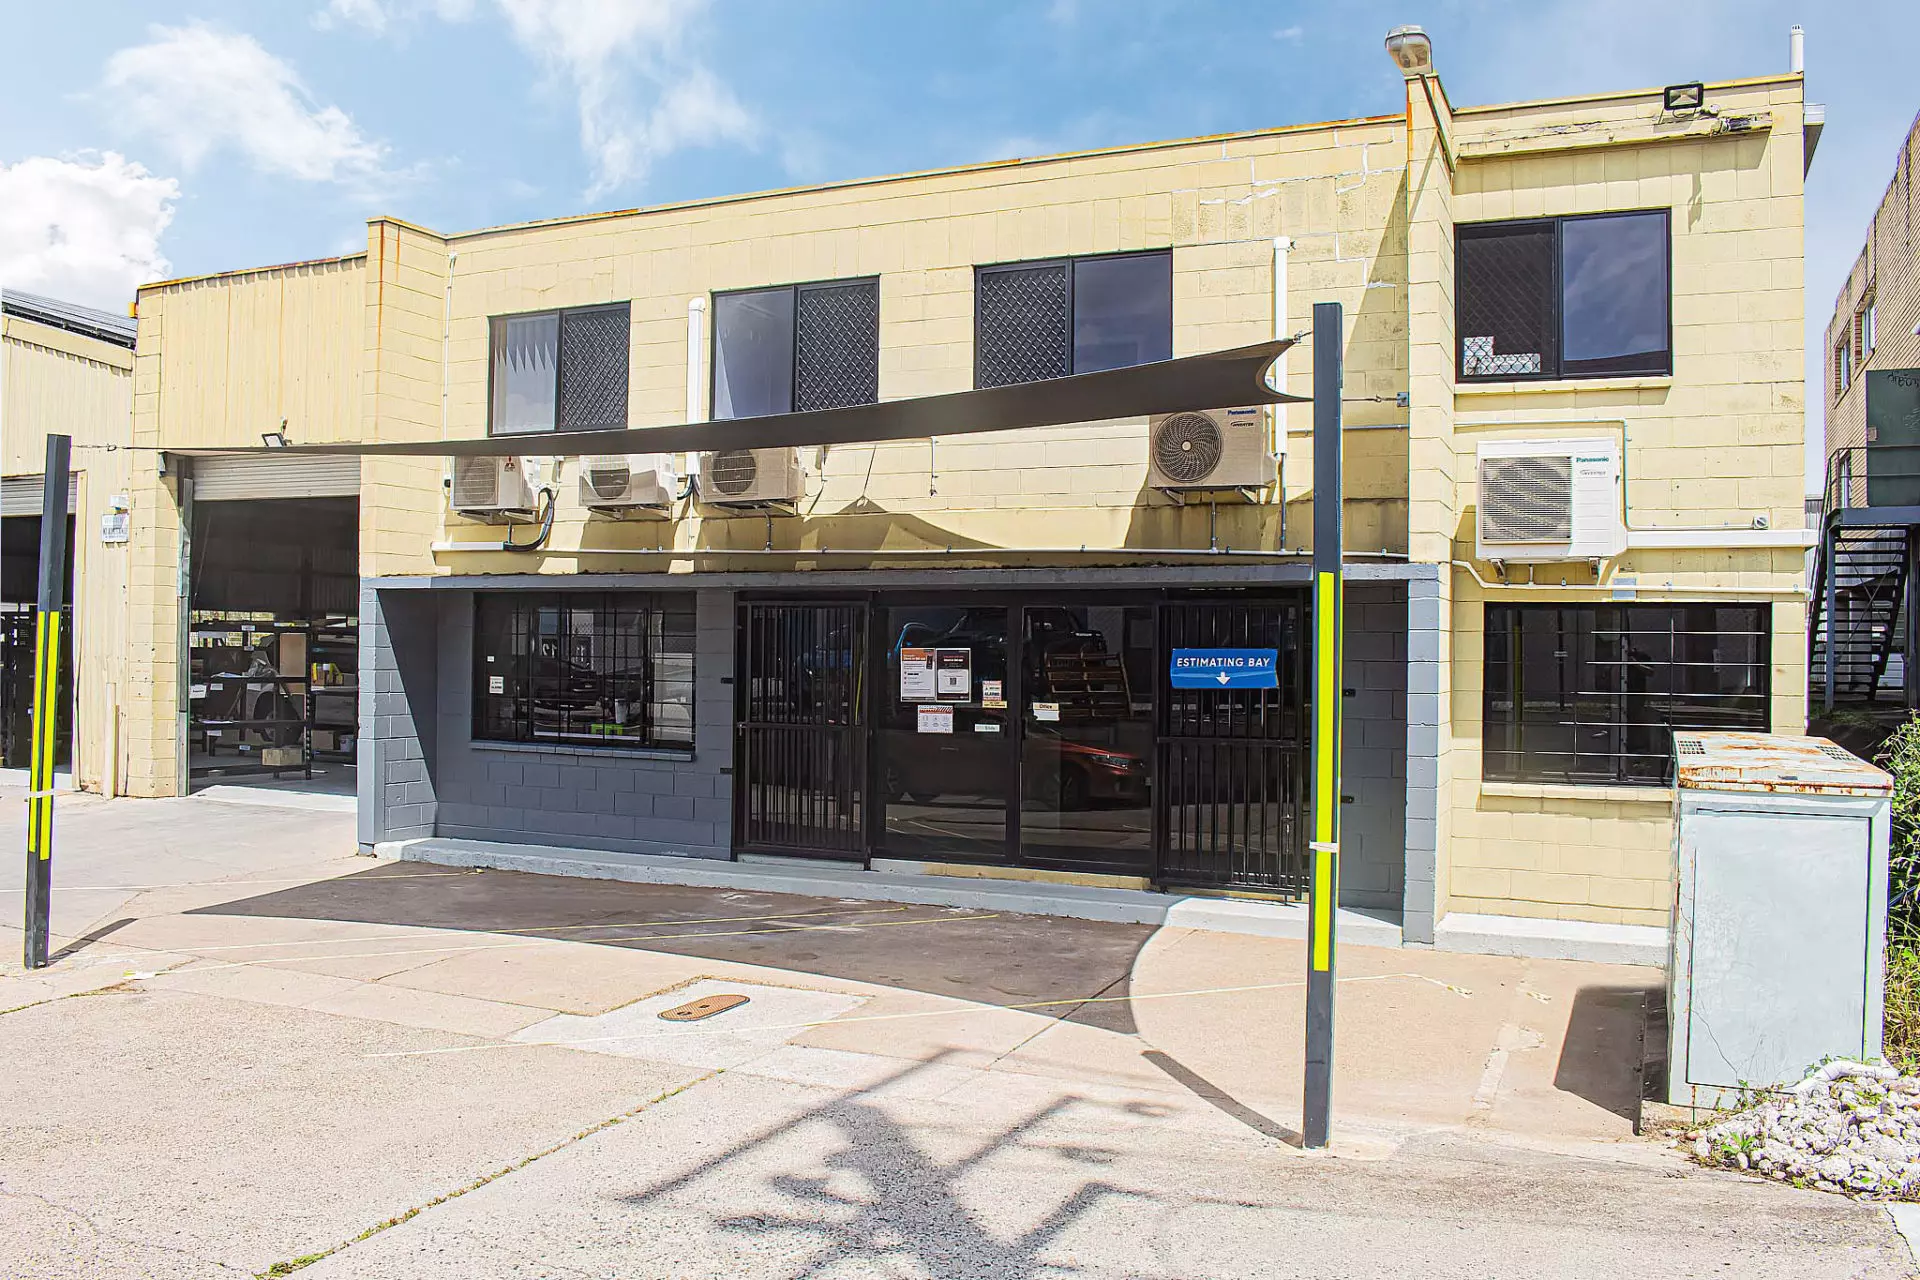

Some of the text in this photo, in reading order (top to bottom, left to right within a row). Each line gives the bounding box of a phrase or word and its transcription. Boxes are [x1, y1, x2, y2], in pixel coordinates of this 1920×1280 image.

[1228, 408, 1257, 416] Panasonic
[1177, 658, 1271, 667] ESTIMATING BAY
